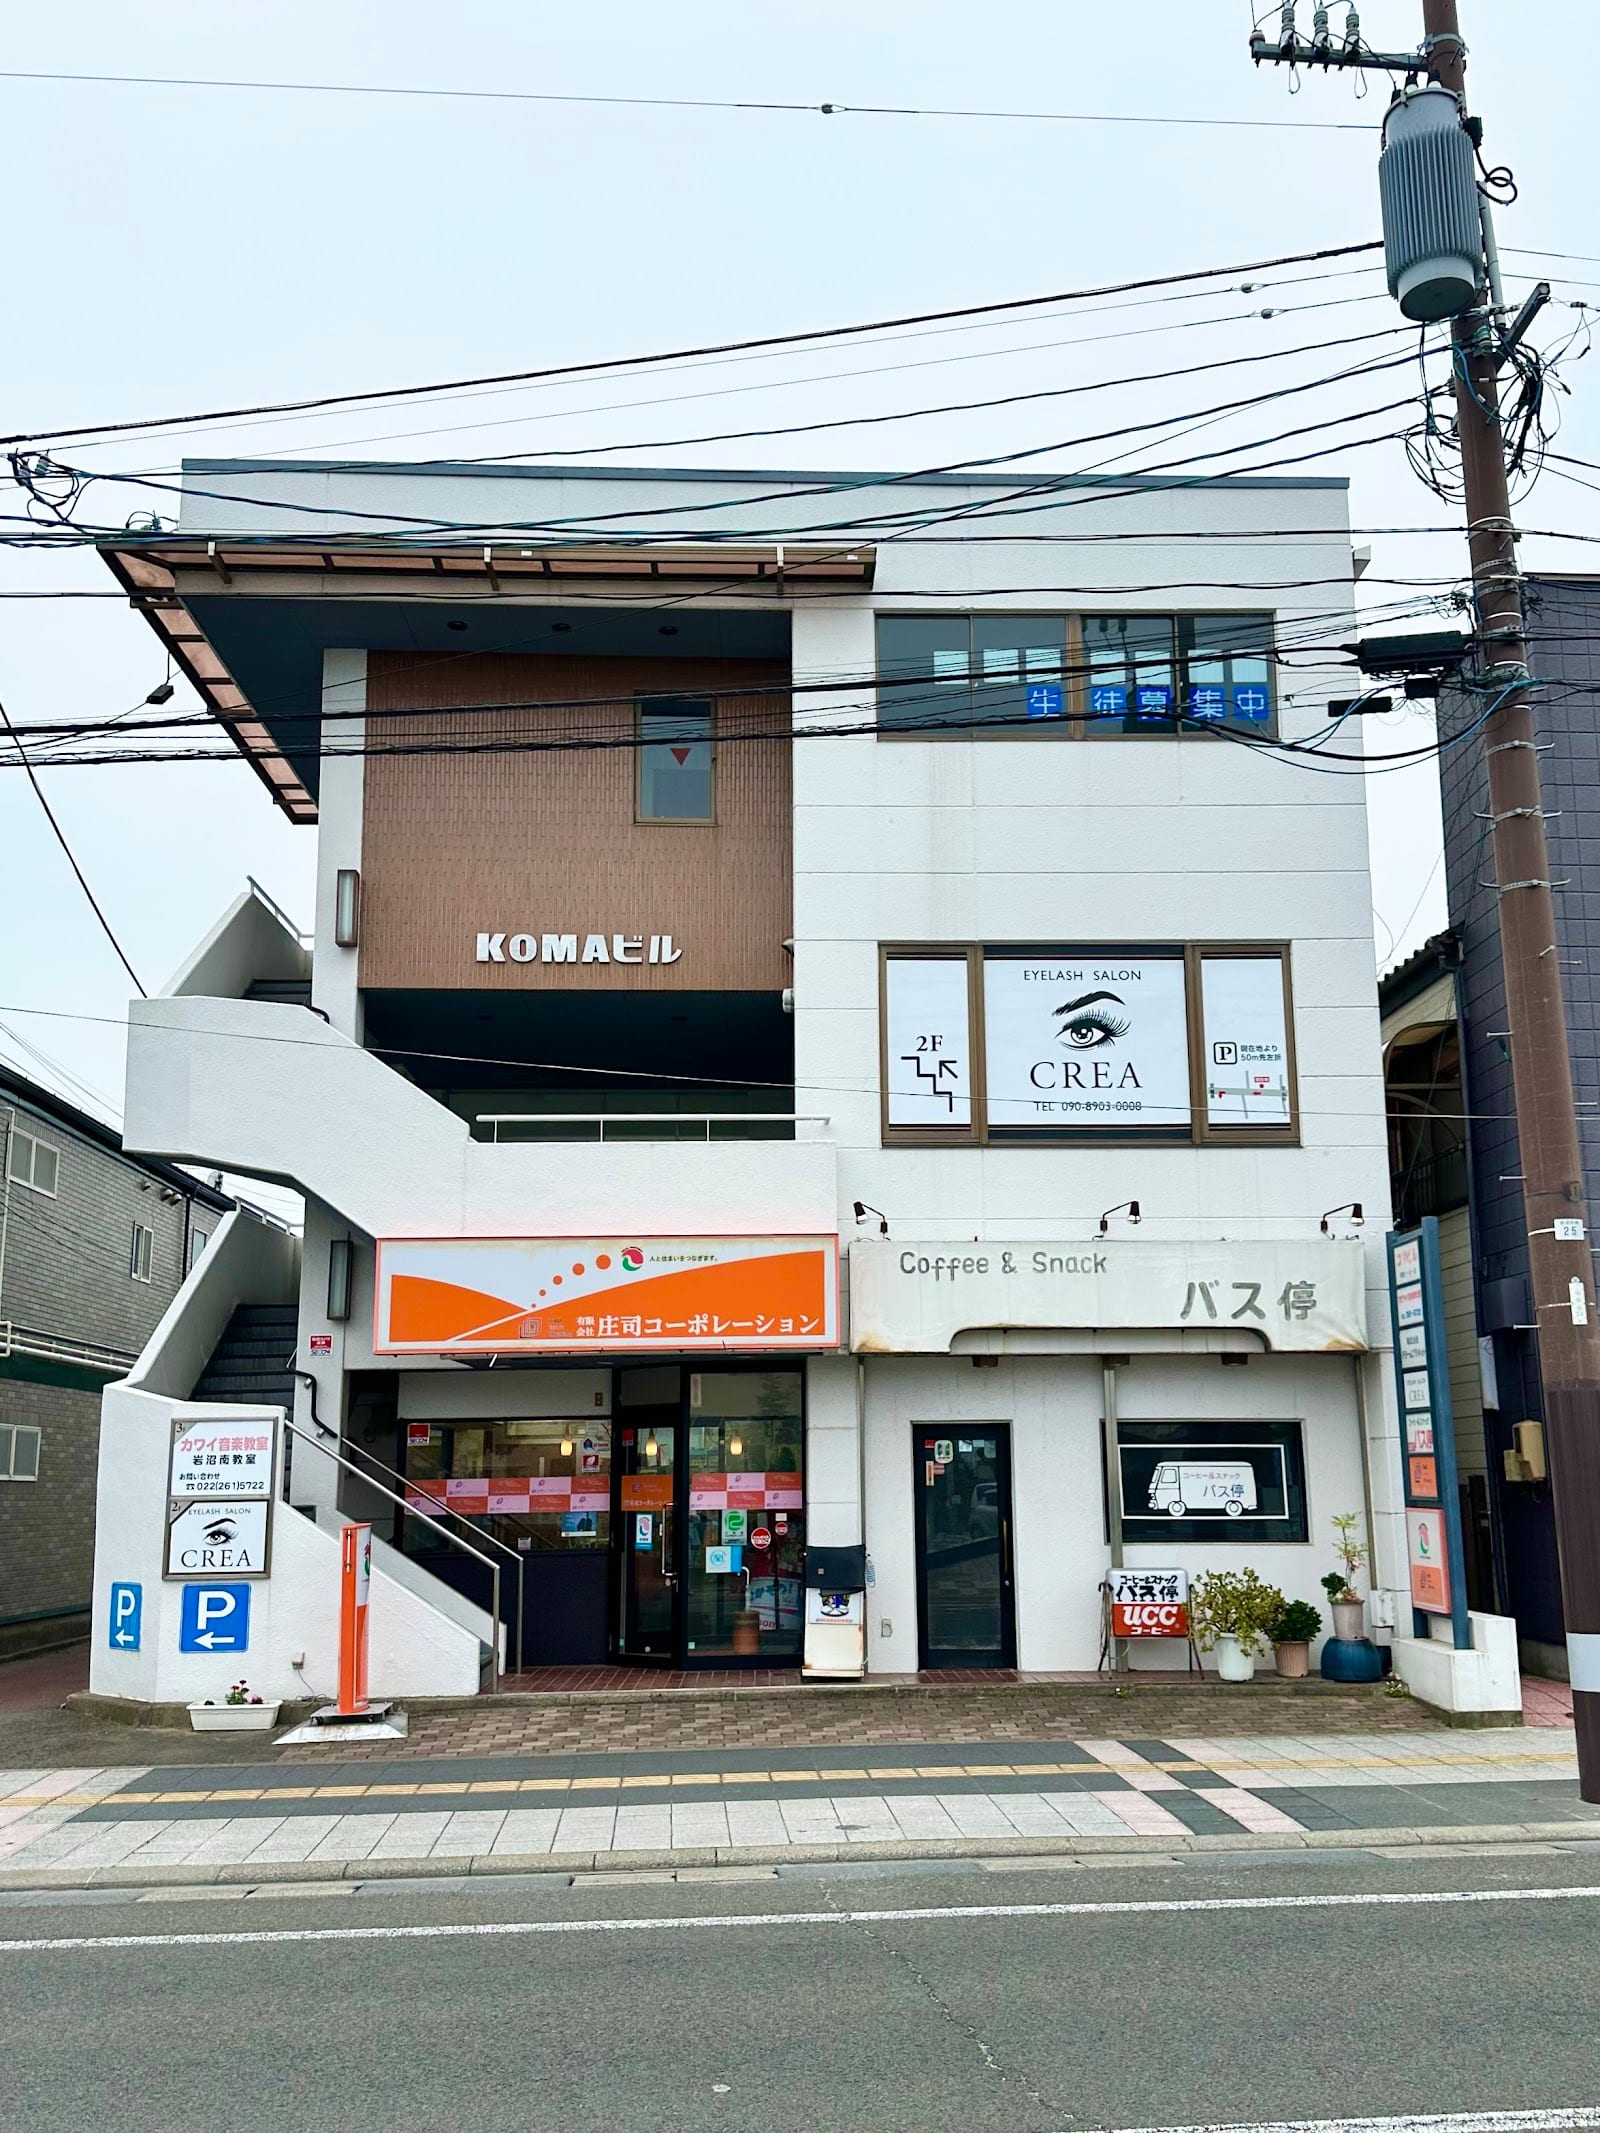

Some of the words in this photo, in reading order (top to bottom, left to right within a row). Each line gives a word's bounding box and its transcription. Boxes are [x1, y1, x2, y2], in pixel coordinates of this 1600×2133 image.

[476, 932, 684, 963] KOMAビル
[1024, 970, 1083, 981] EYELASH
[1093, 970, 1141, 981] SALON
[916, 1035, 943, 1052] 2F
[1219, 1046, 1232, 1060] P
[1030, 1061, 1143, 1089] CREA
[1033, 1101, 1054, 1112] TEL
[1061, 1100, 1142, 1112] 090-8903-0008
[1563, 1226, 1577, 1236] 25
[899, 1251, 989, 1281] Coffee
[1001, 1252, 1017, 1273] &
[1032, 1252, 1107, 1273] Snack
[1180, 1279, 1317, 1321] バス停
[597, 1313, 820, 1337] 庄司コーポレーション
[180, 1436, 269, 1452] カワイ音楽教室
[192, 1453, 256, 1465] 岩沼南教室
[196, 1481, 265, 1490] 022(261)5722
[1203, 1484, 1245, 1498] バス停
[188, 1508, 220, 1516] EYELASH
[225, 1507, 251, 1515] SALON
[180, 1549, 252, 1568] CREA
[1120, 1575, 1178, 1584] コーヒー&スナック
[1116, 1585, 1179, 1602] バス停
[116, 1590, 135, 1627] P
[196, 1591, 236, 1630] P
[1130, 1626, 1171, 1635] コーヒー
